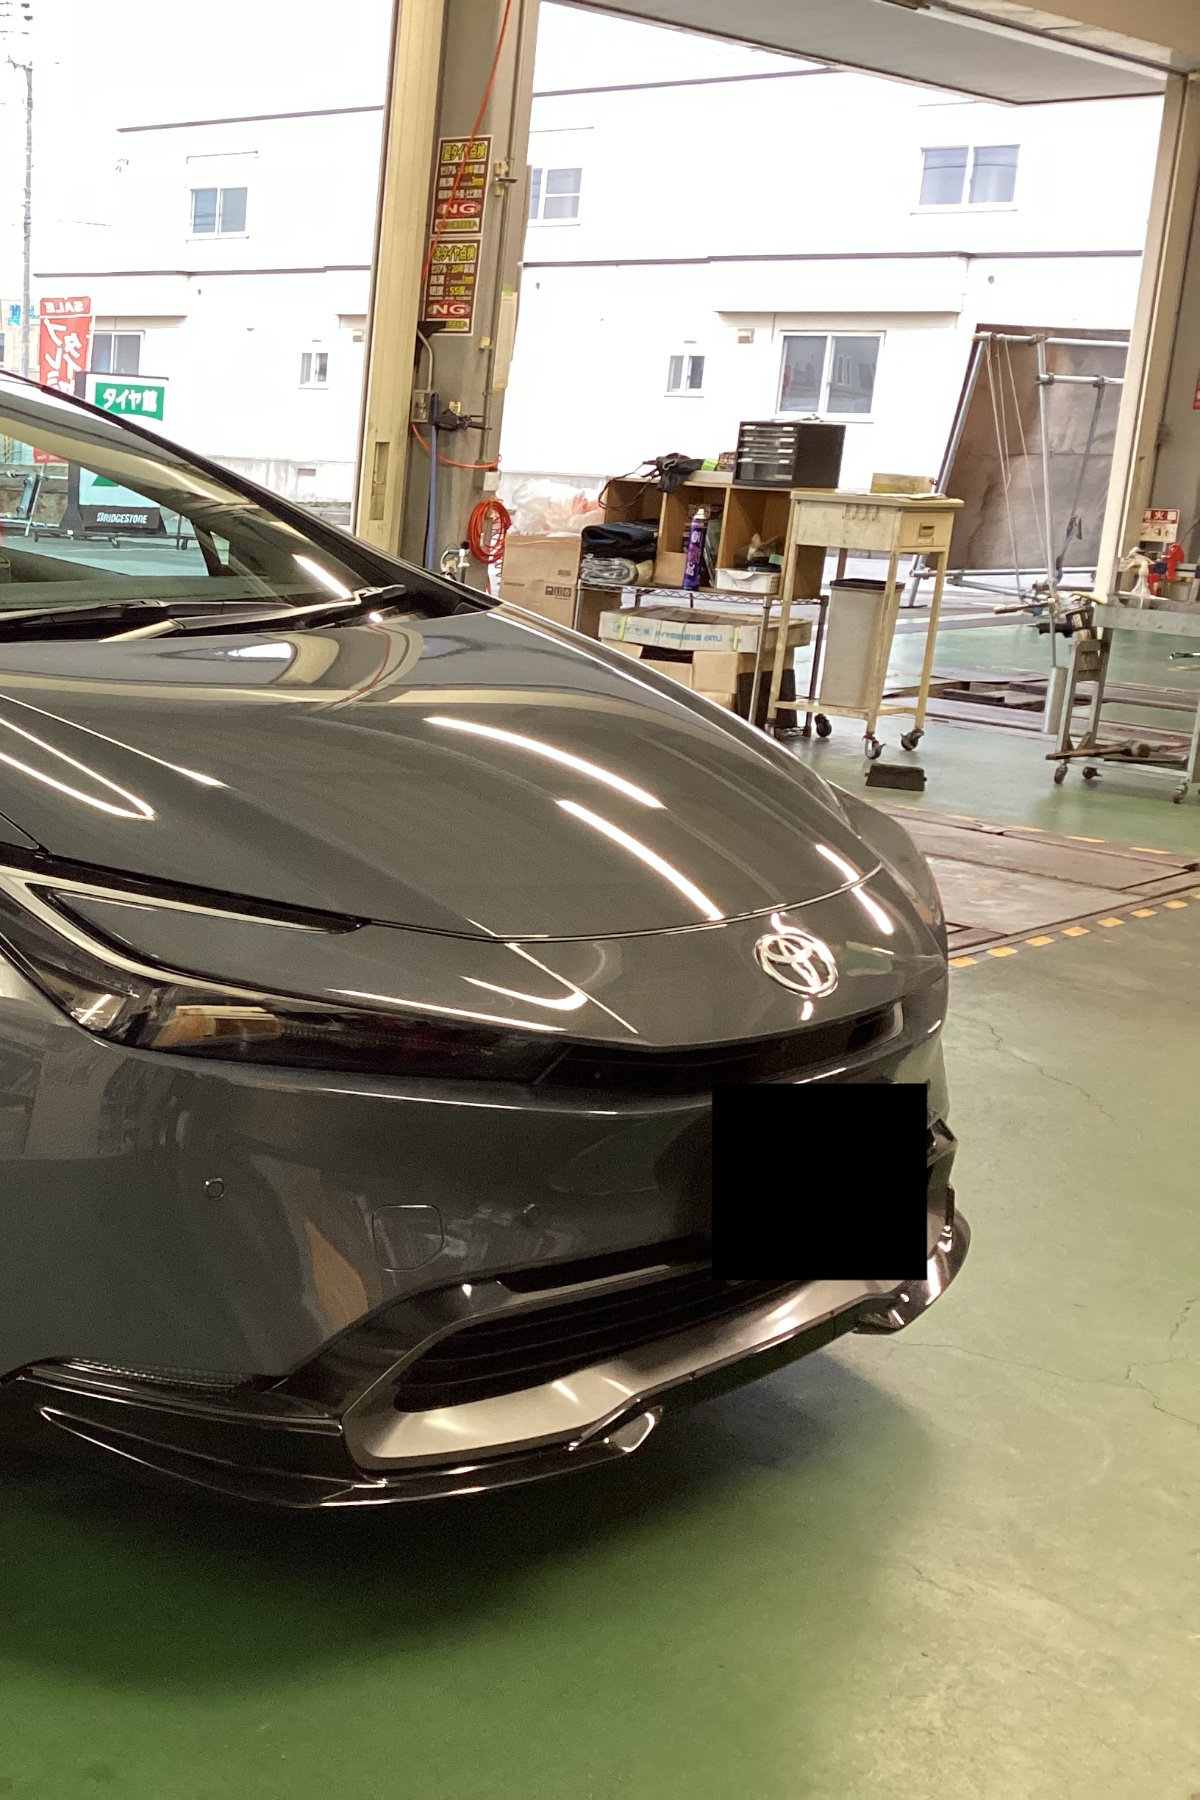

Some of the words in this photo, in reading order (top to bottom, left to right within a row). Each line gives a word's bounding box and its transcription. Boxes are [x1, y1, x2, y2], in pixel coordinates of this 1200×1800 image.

[441, 203, 476, 214] NG
[432, 304, 465, 315] NG
[103, 388, 158, 412] タイヤ館
